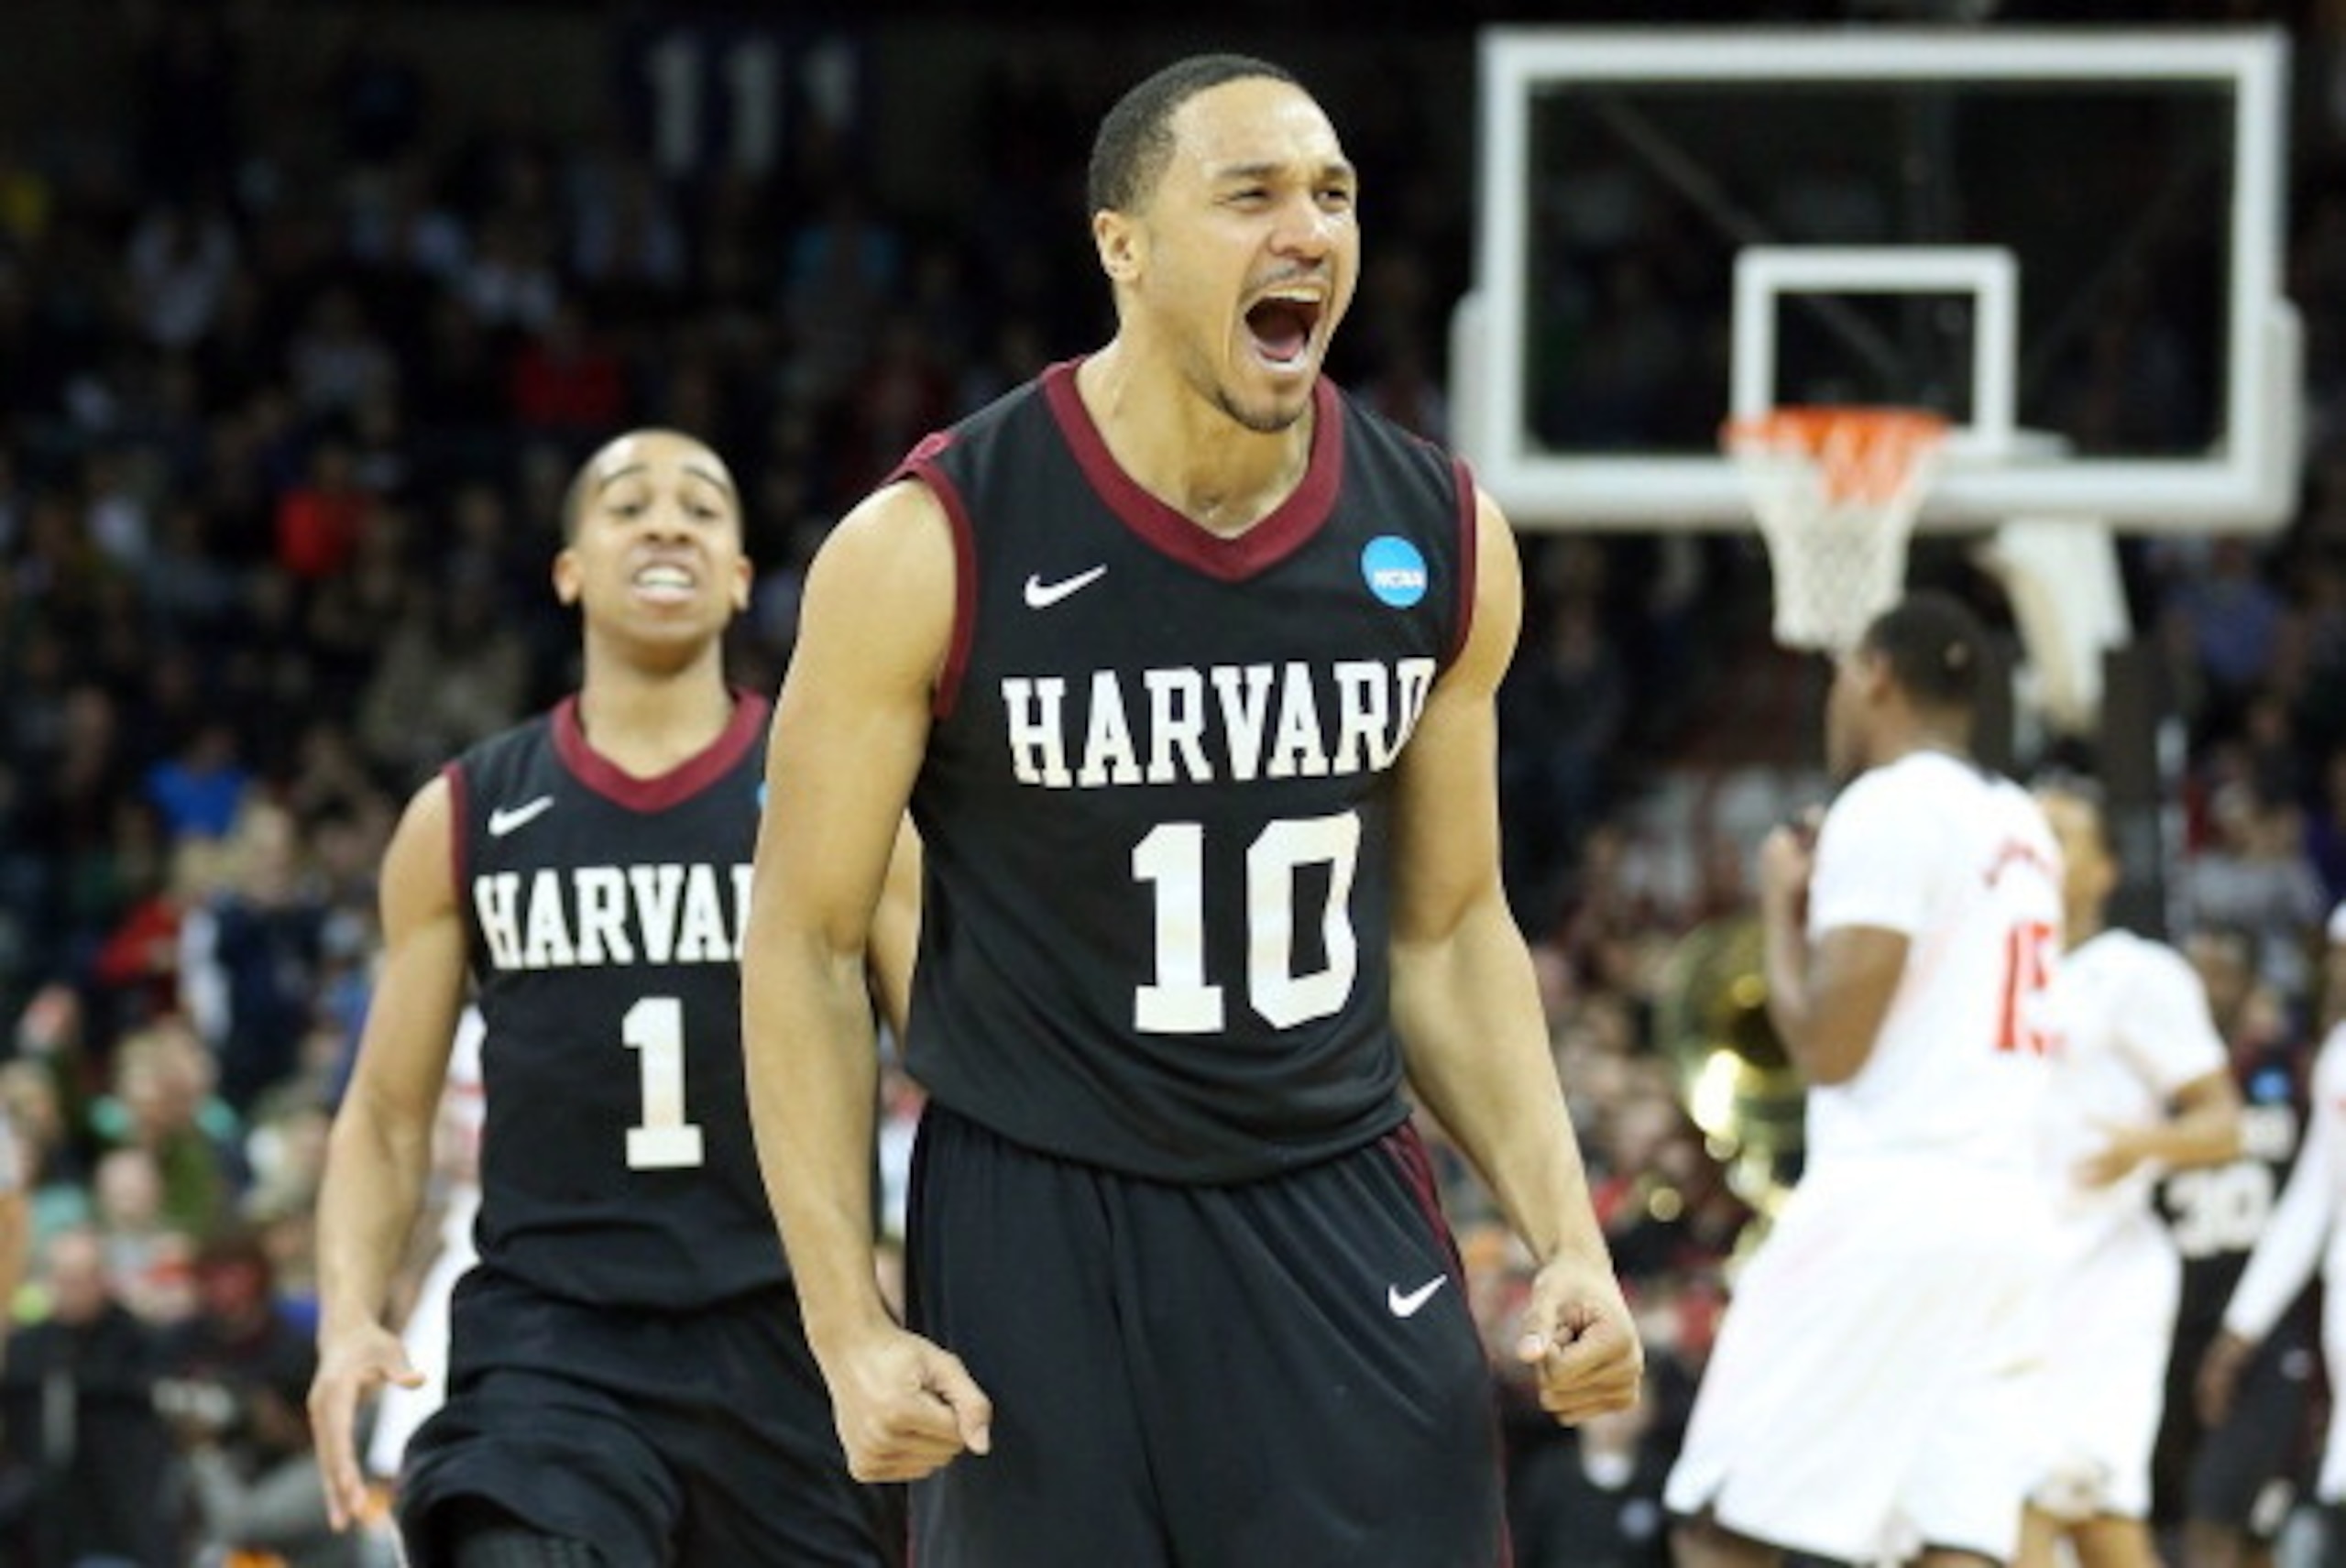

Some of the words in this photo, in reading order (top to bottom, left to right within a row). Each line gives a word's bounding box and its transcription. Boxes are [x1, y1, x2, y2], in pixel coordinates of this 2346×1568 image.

[1003, 657, 1435, 787] HARVARD
[1133, 810, 1361, 1032] 10
[622, 997, 704, 1168] 1
[2161, 1160, 2276, 1259] 30
